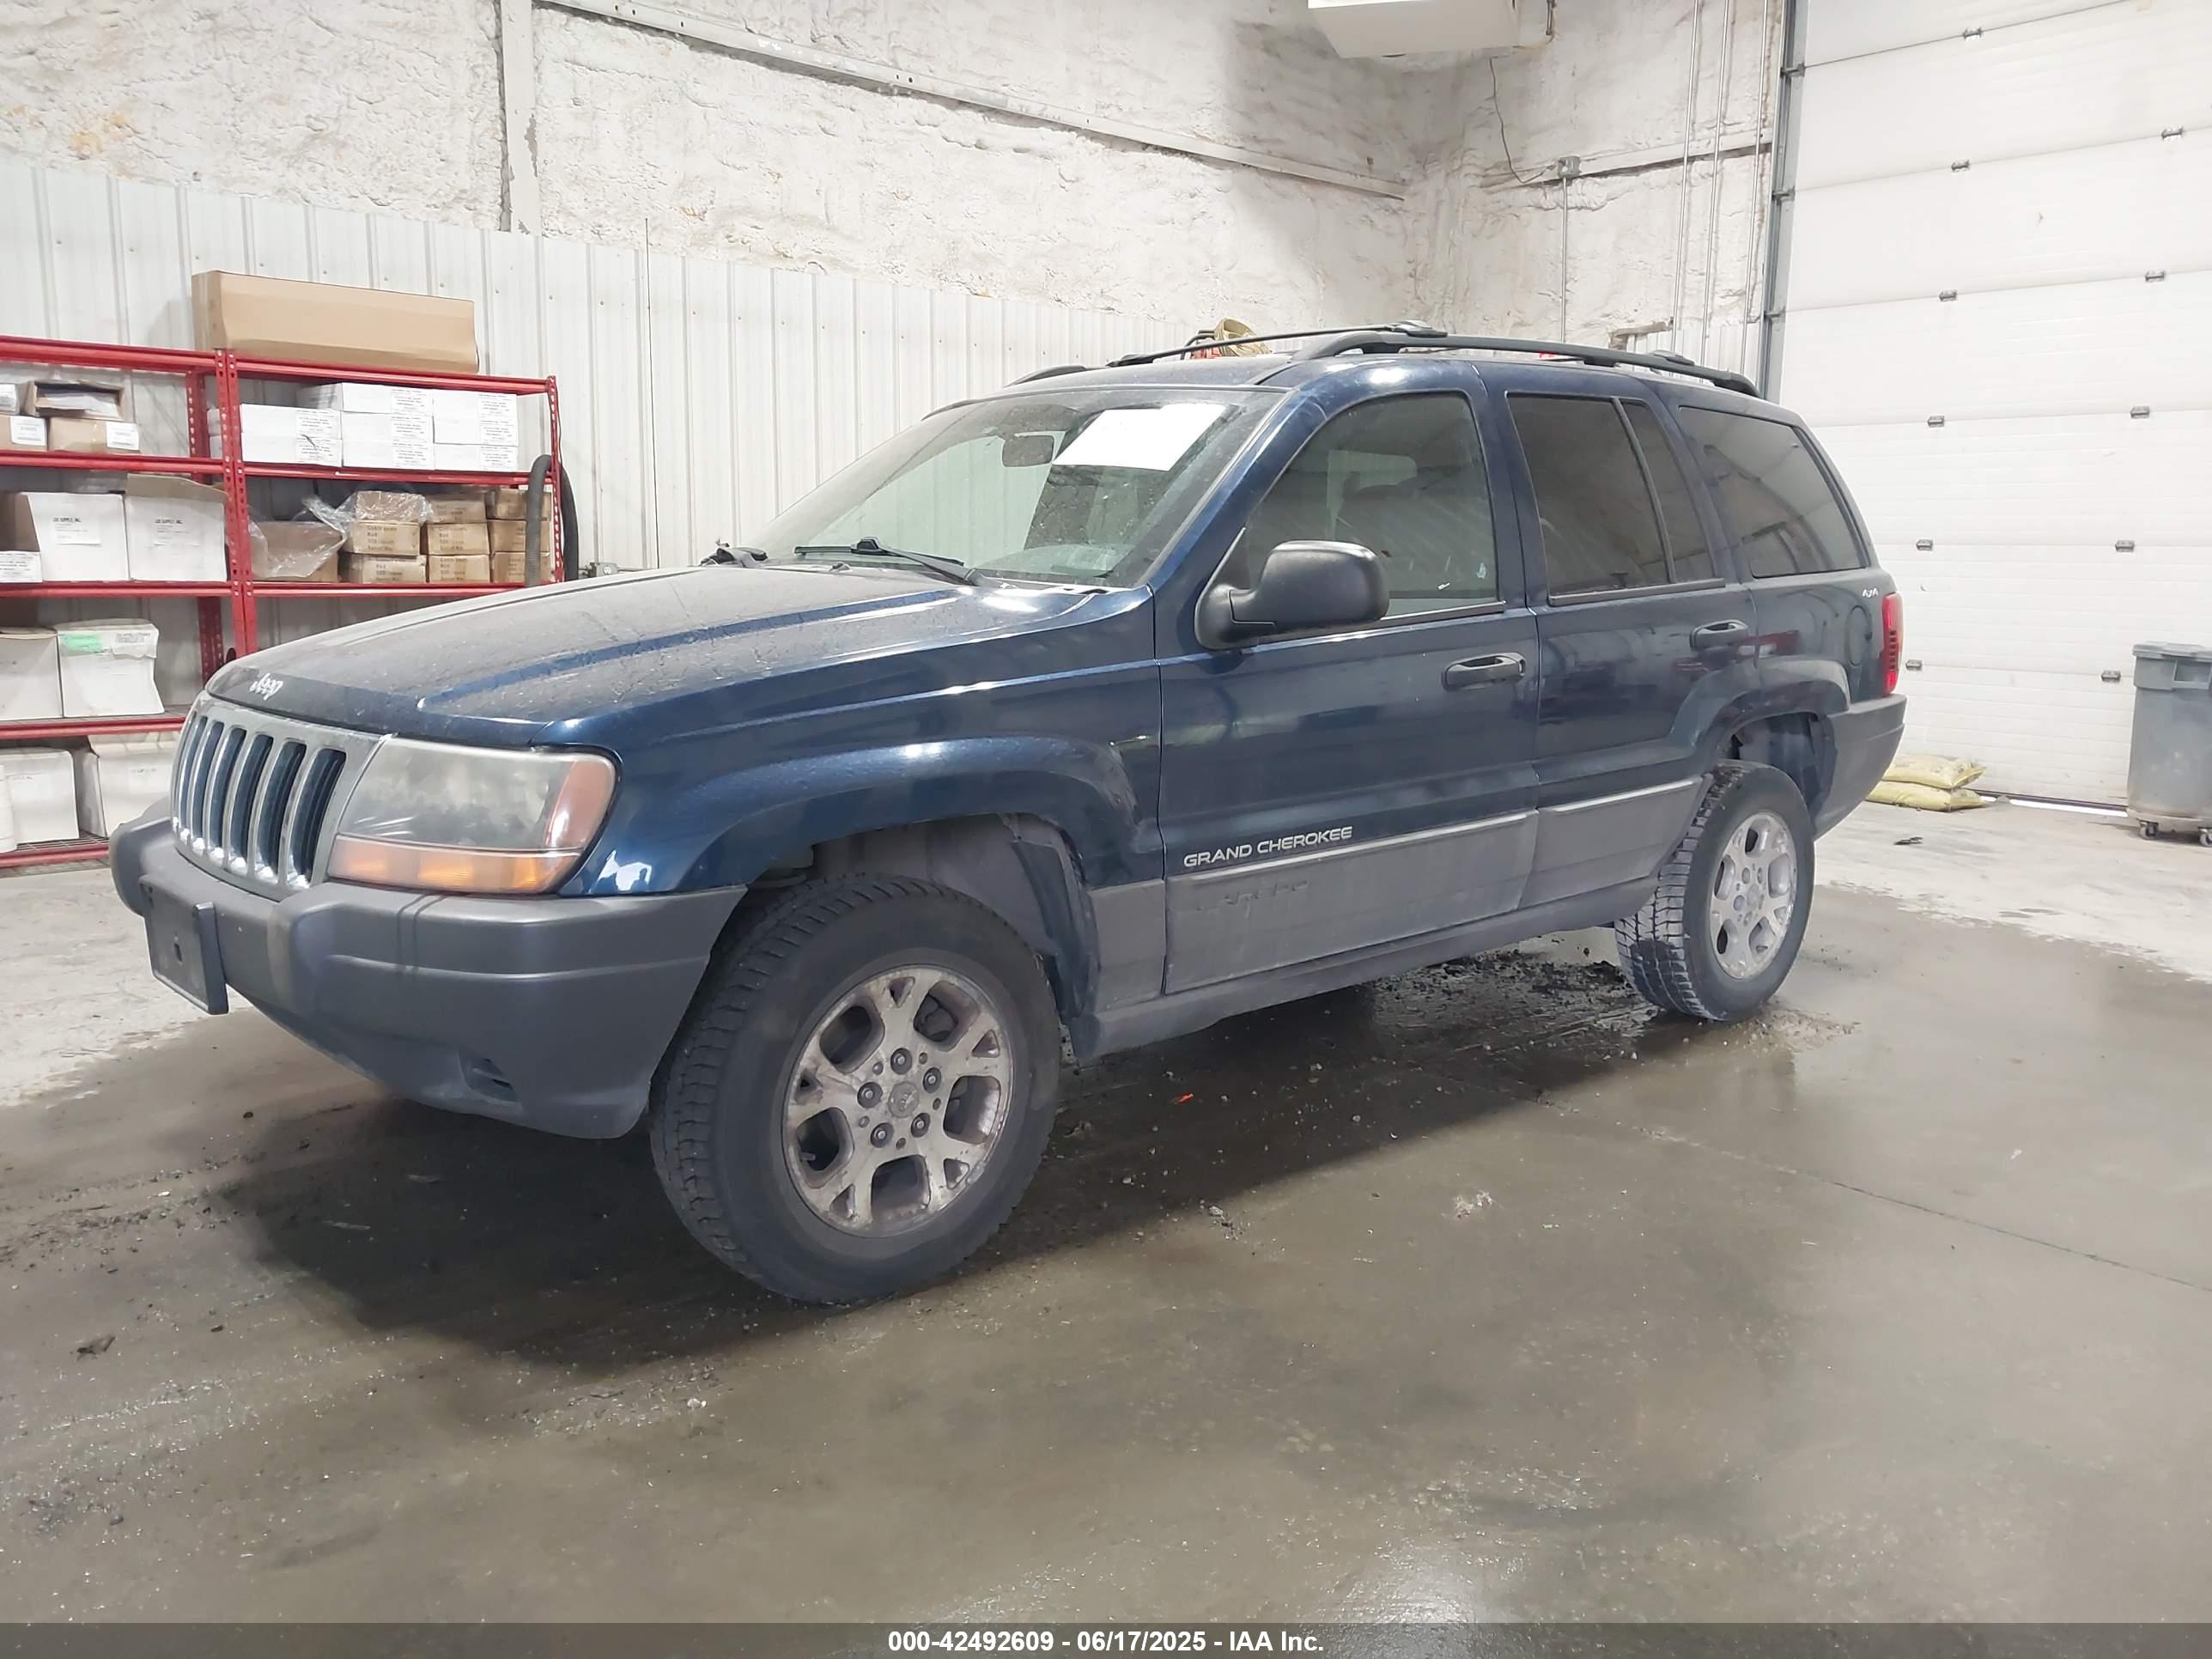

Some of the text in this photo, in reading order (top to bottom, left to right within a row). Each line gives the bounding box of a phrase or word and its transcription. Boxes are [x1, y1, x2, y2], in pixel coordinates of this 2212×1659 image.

[249, 672, 283, 701] Jeep
[1183, 826, 1352, 867] GRAND CHEROKEE
